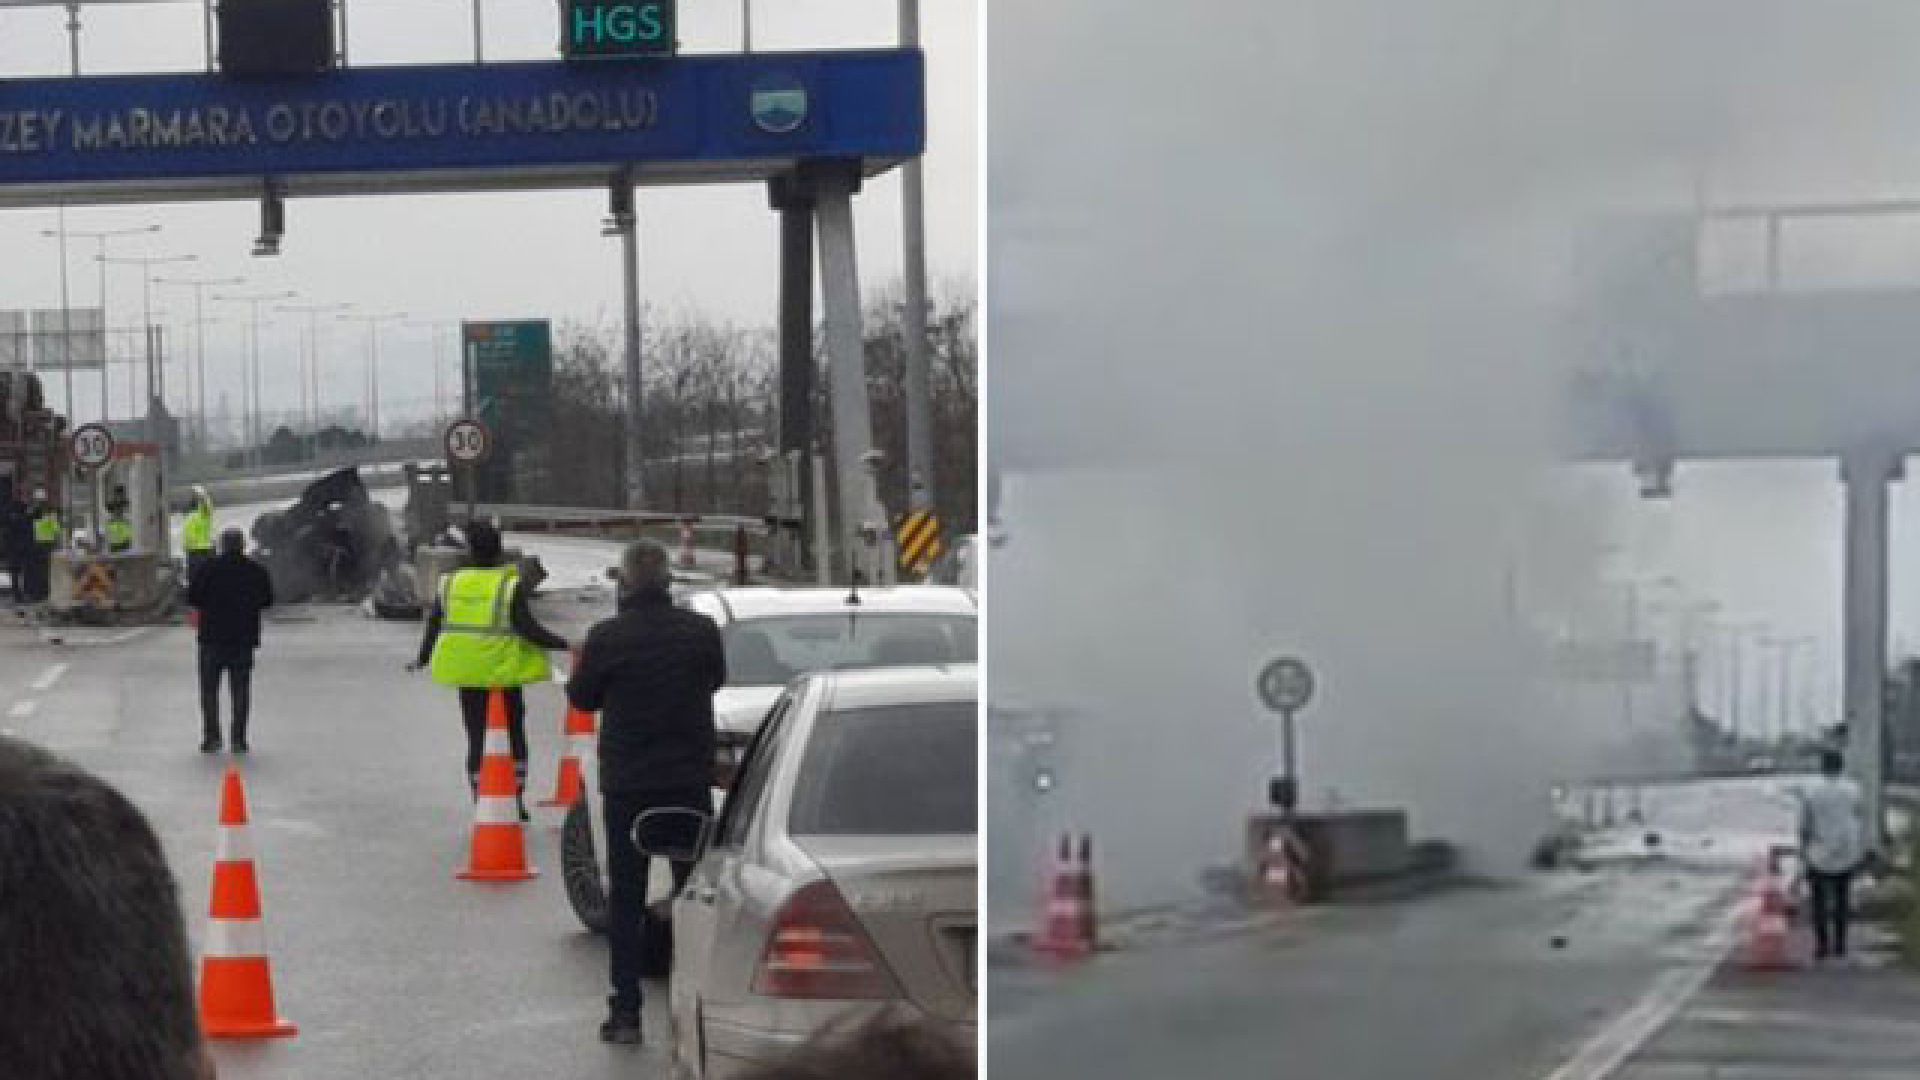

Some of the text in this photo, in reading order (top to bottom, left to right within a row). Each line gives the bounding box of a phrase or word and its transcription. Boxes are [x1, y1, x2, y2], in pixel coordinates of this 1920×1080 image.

[574, 4, 662, 43] HGS
[72, 103, 257, 151] MARMARA
[266, 98, 446, 142] OTOYOLU
[458, 90, 658, 135] (ANADOLU)
